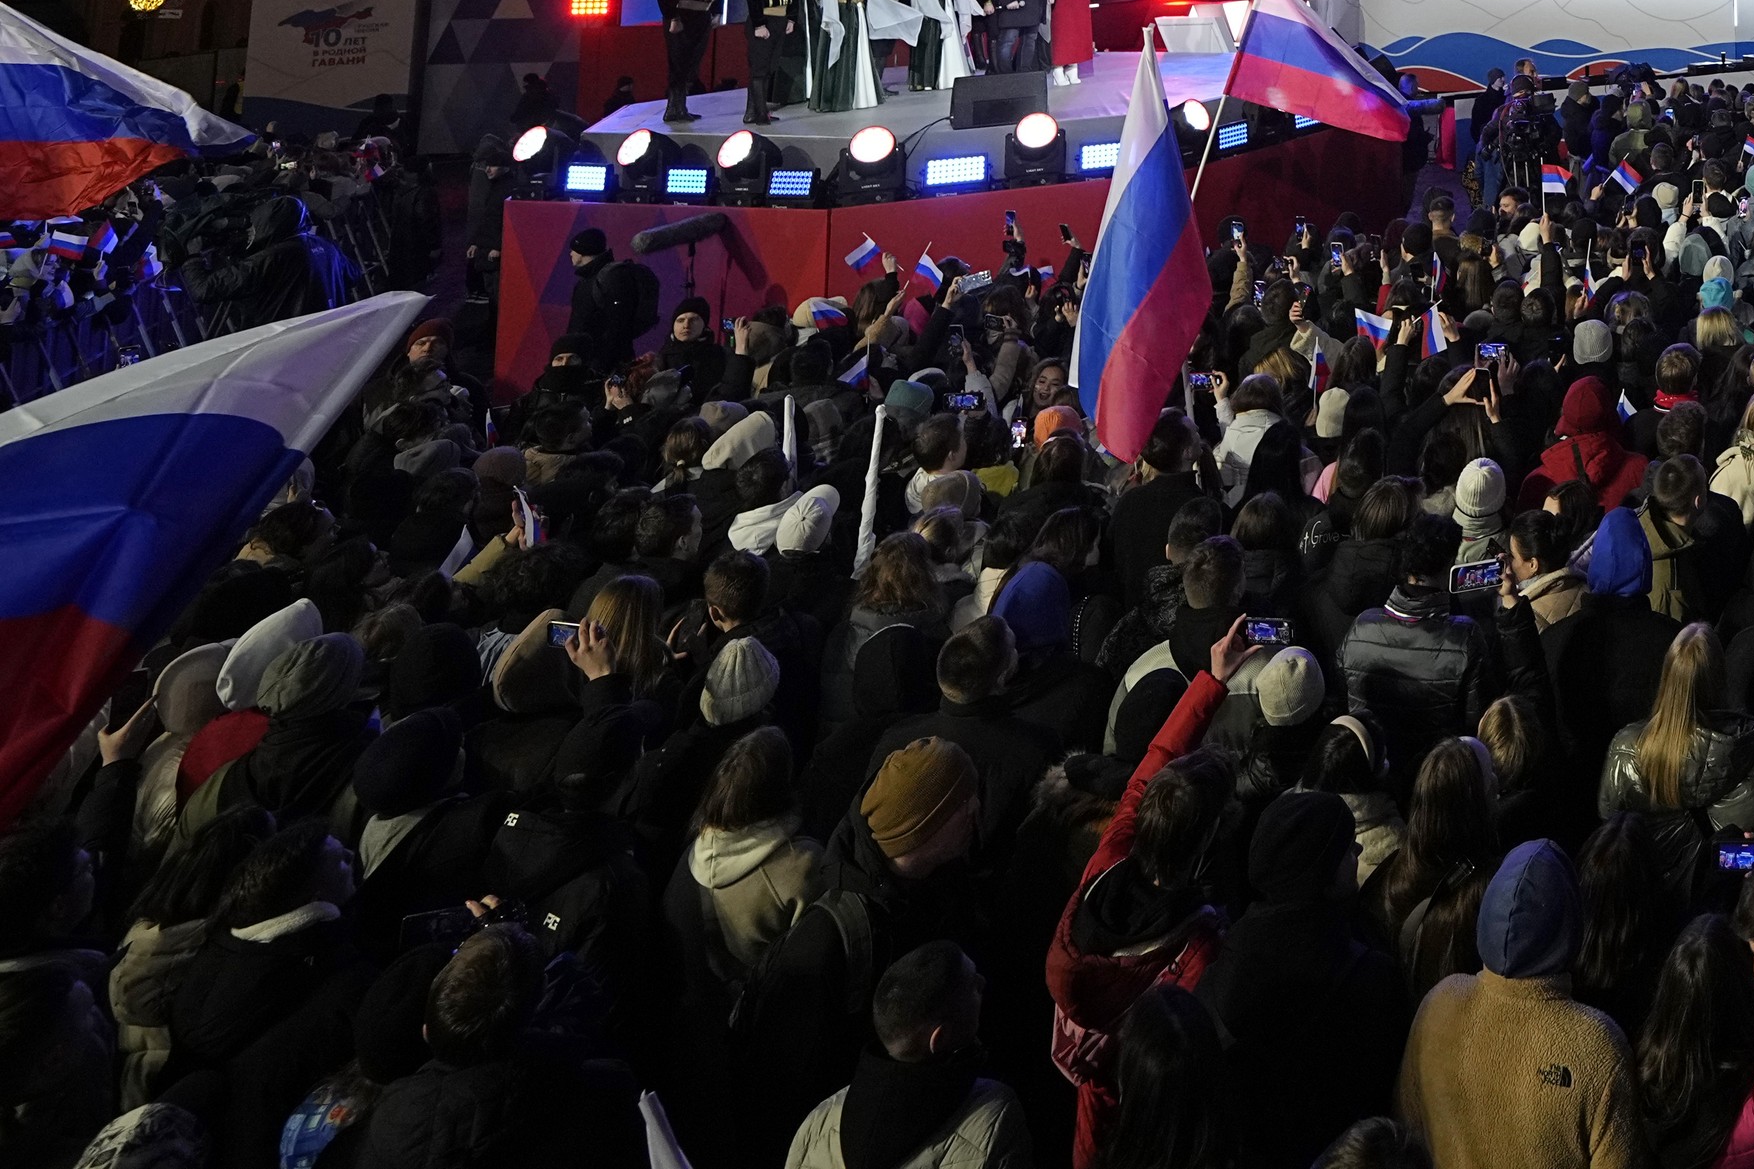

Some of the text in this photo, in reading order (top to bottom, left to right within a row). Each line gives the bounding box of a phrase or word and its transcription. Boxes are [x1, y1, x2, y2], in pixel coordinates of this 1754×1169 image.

[311, 28, 342, 47] 10
[343, 36, 367, 45] ЛЕТ
[322, 47, 366, 56] РОДНОЙ
[312, 55, 366, 67] ГАВАНИ
